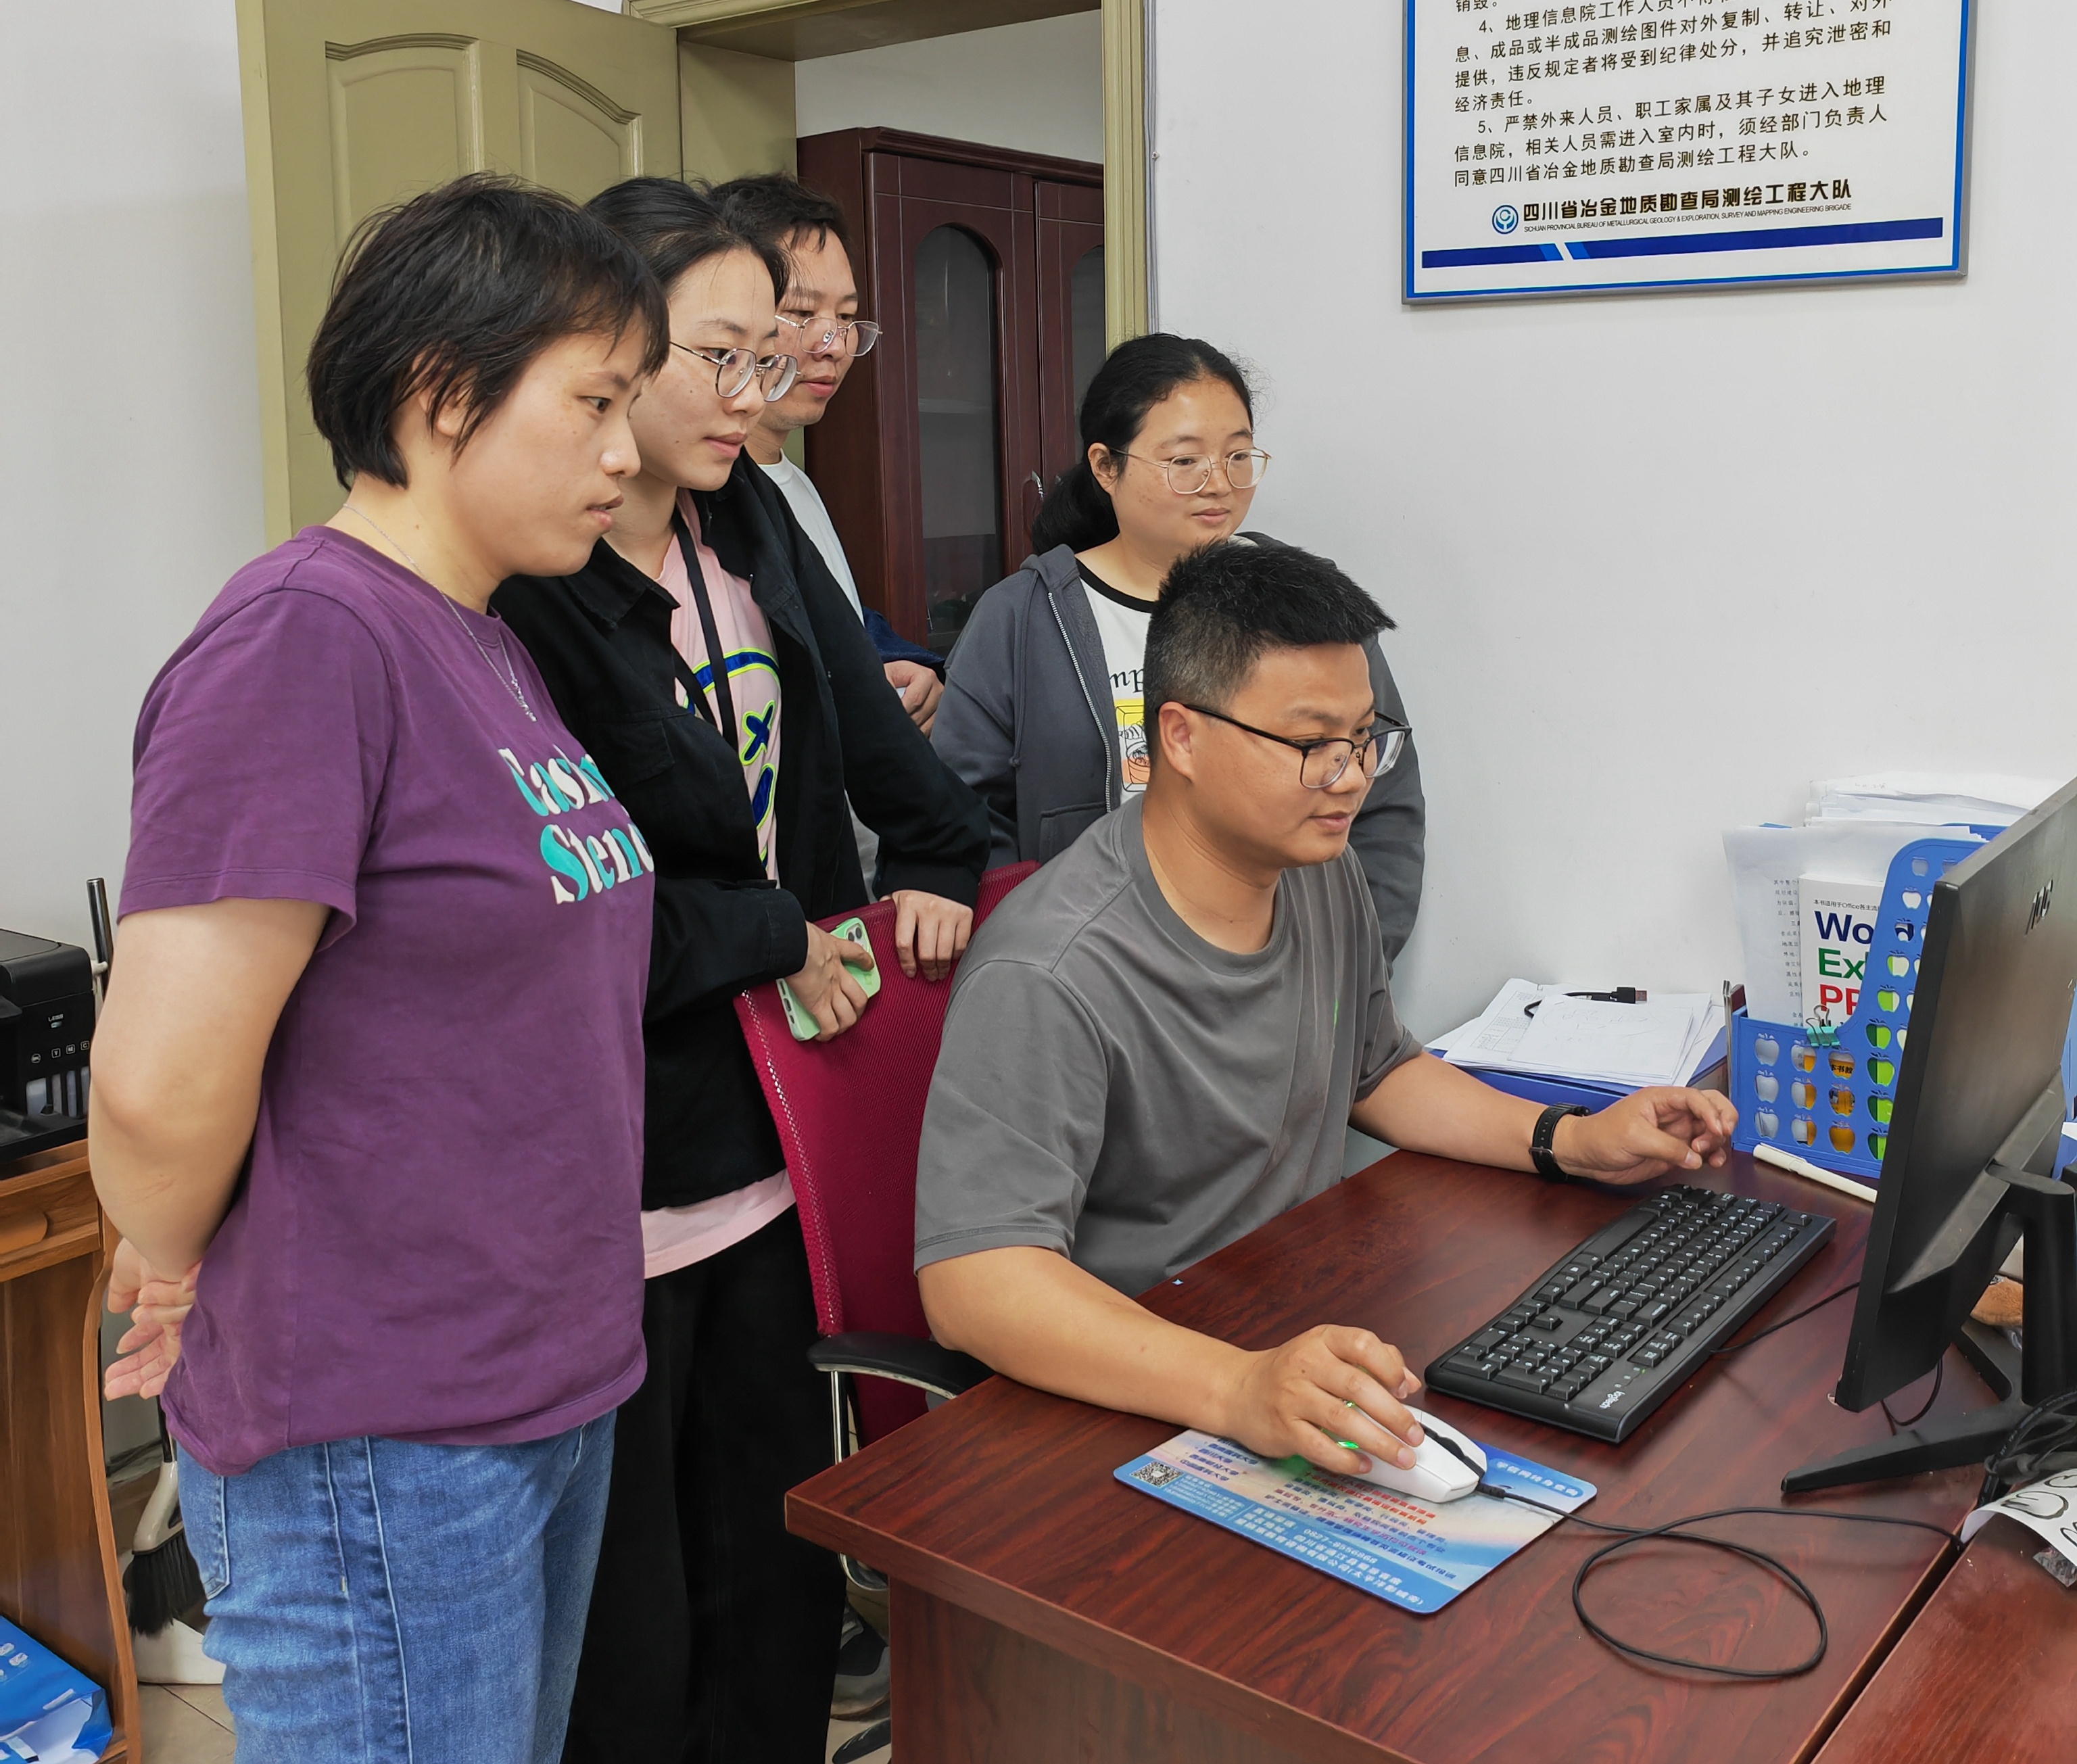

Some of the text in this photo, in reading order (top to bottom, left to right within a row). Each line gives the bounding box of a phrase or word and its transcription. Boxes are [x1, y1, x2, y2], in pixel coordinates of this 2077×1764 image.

[1455, 19, 1891, 88] 提供，违反规定者将受到纪律处分，并追究泄密和
[1455, 90, 1532, 112] 经济责任。
[1477, 75, 1886, 133] 5、严禁外来人员、职工家属及其子女进入地理
[1454, 103, 1888, 162] 信息院，相关人员需进入室内时，须经部门负责人
[1454, 140, 1811, 187] 同意四川省冶金地质勘查局测绘工程大队。
[1523, 178, 1852, 222] 四川省冶金地质勘查局测绘工程大队
[1577, 221, 1598, 229] BUREAU
[1607, 218, 1649, 227] METALLURGICAL
[1650, 216, 1676, 224] GEOLOGY
[1721, 211, 1744, 219] SURVEY
[1757, 208, 1784, 216] MAPPING
[1784, 205, 1824, 214] ENGINEERING
[1825, 203, 1852, 212] BRIGADE
[1814, 899, 1880, 911] 本书适用于Office各主流
[1814, 910, 1874, 945] Wo
[1820, 984, 1860, 1016] PP
